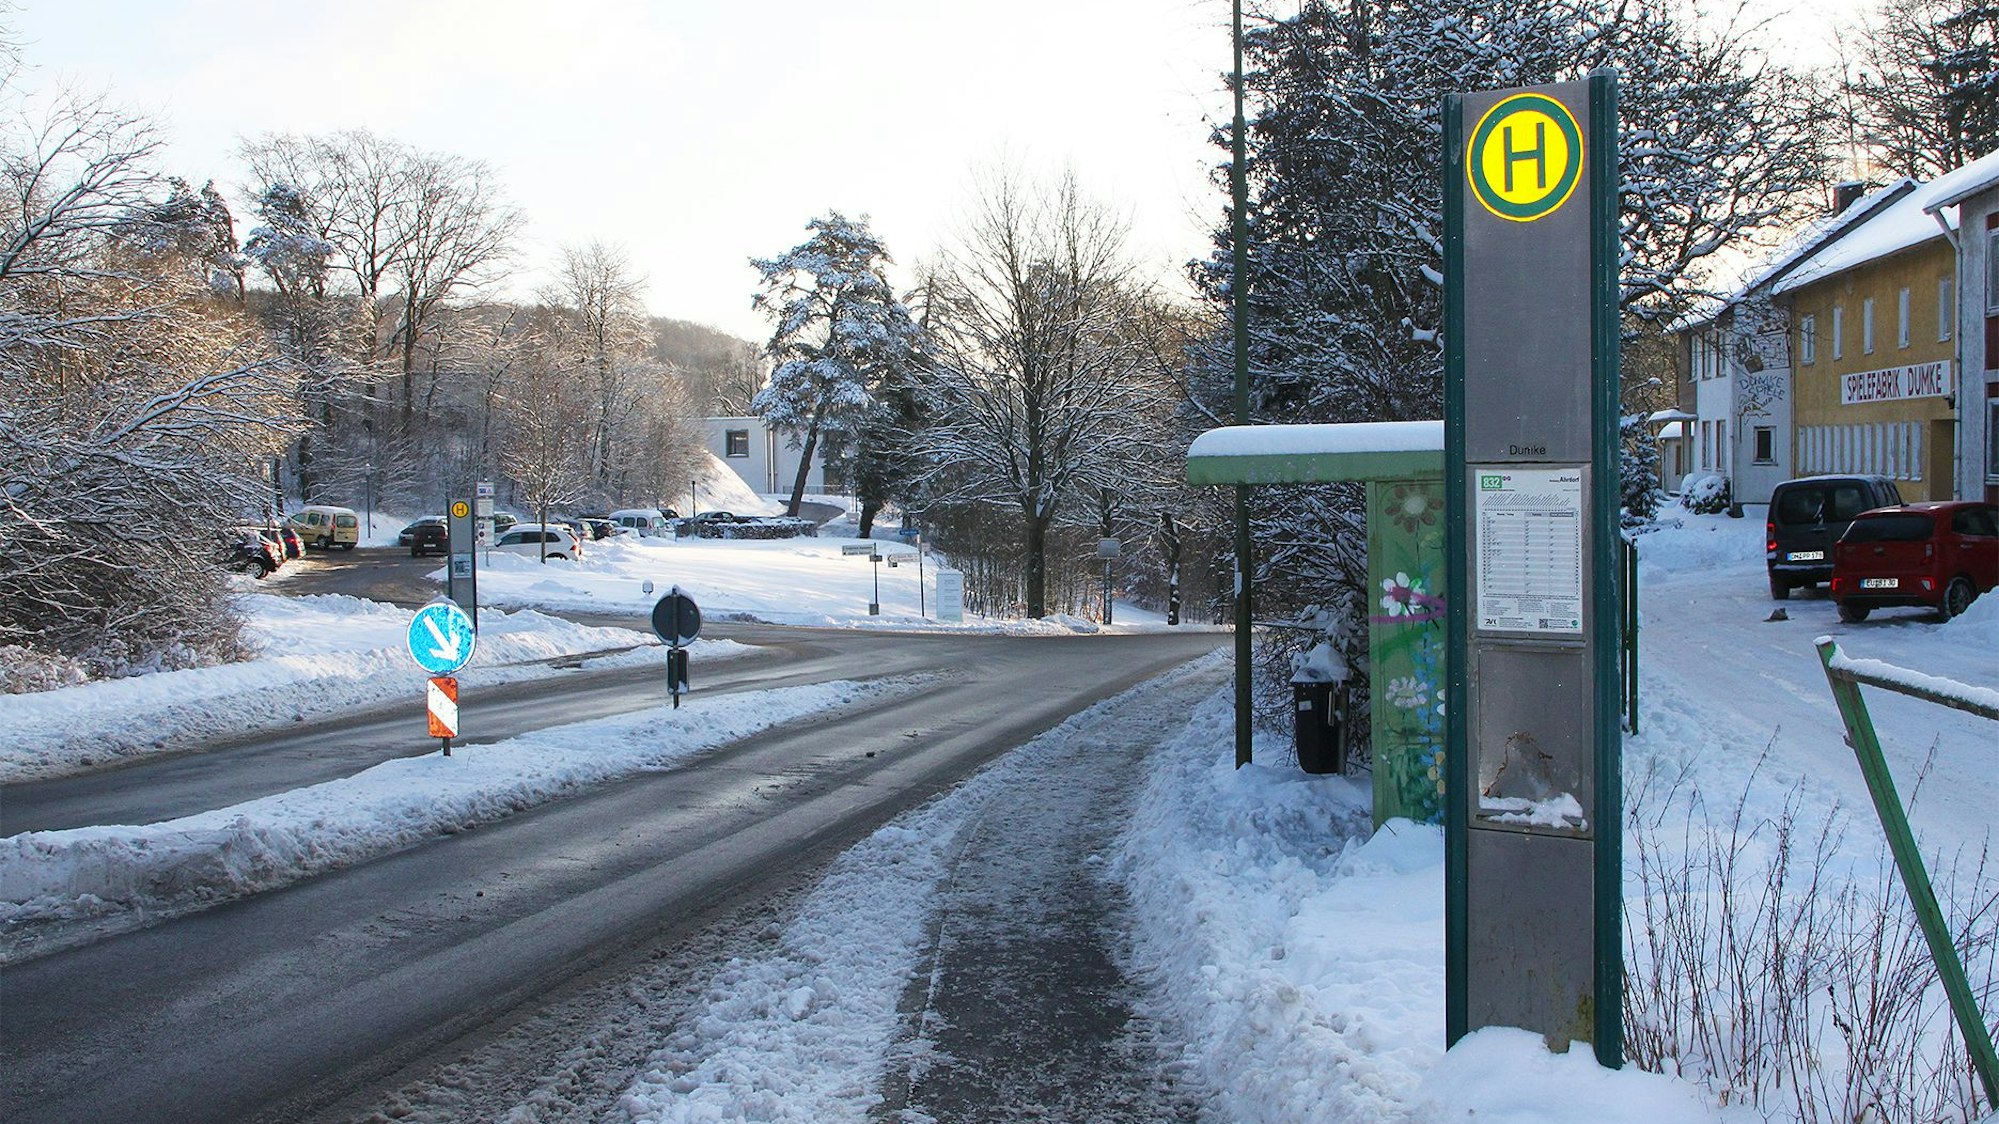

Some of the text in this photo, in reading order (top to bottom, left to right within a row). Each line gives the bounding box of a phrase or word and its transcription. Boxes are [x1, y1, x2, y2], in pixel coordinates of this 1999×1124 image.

[1504, 122, 1546, 192] H
[1847, 363, 1941, 401] SPIELEFABRIK DUMKE
[1509, 444, 1547, 455] Dumke
[1483, 477, 1501, 488] 832
[456, 505, 464, 514] H
